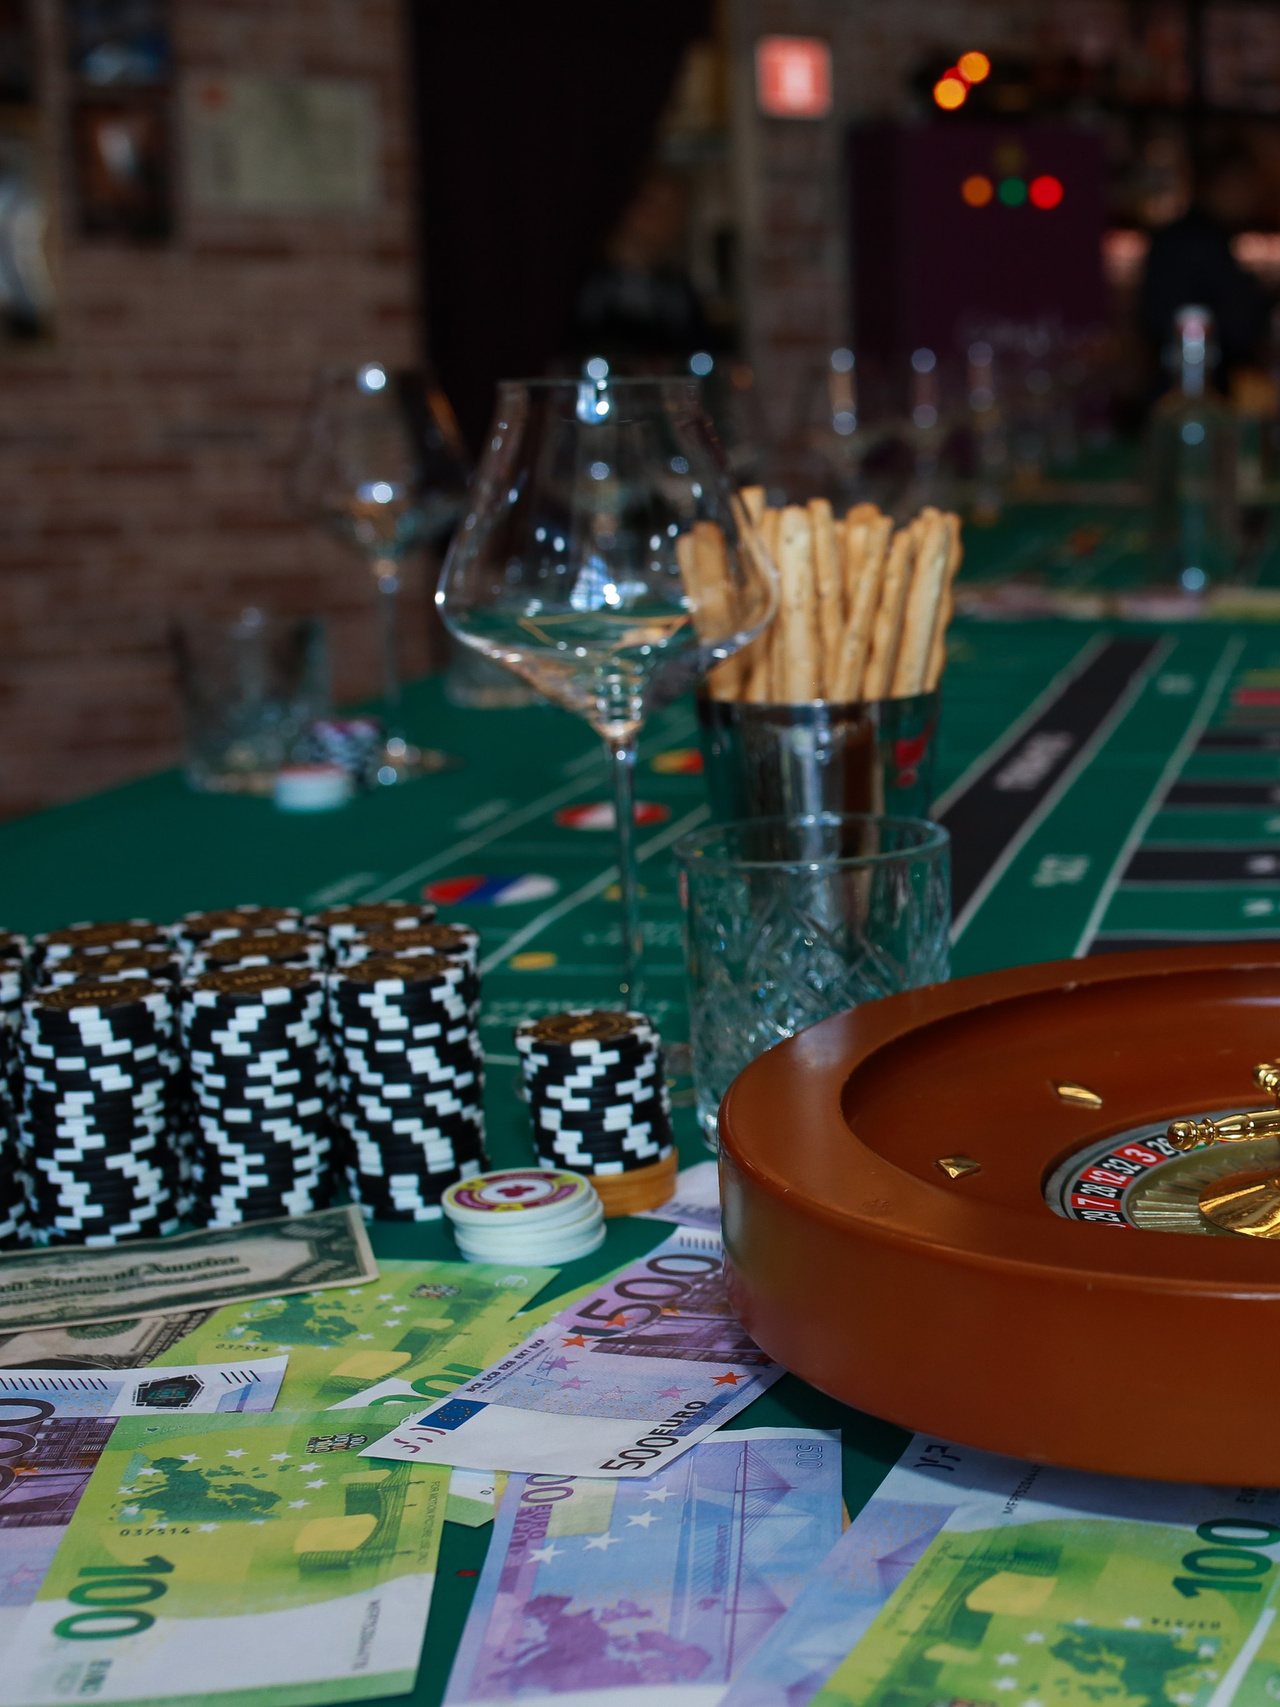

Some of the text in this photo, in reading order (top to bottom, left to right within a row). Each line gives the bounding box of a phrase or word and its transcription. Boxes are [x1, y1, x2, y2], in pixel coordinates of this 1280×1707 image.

[1123, 1147, 1158, 1164] 3
[1088, 1170, 1128, 1186] 12
[1079, 1182, 1119, 1199] 28
[1077, 1197, 1115, 1208] 7
[1080, 1210, 1122, 1223] 29
[576, 1253, 723, 1327] 500
[599, 1399, 706, 1471] 500 EURO
[795, 1443, 824, 1470] 500
[533, 1503, 554, 1541] EURO
[118, 1526, 192, 1538] 037514
[52, 1553, 176, 1641] 100
